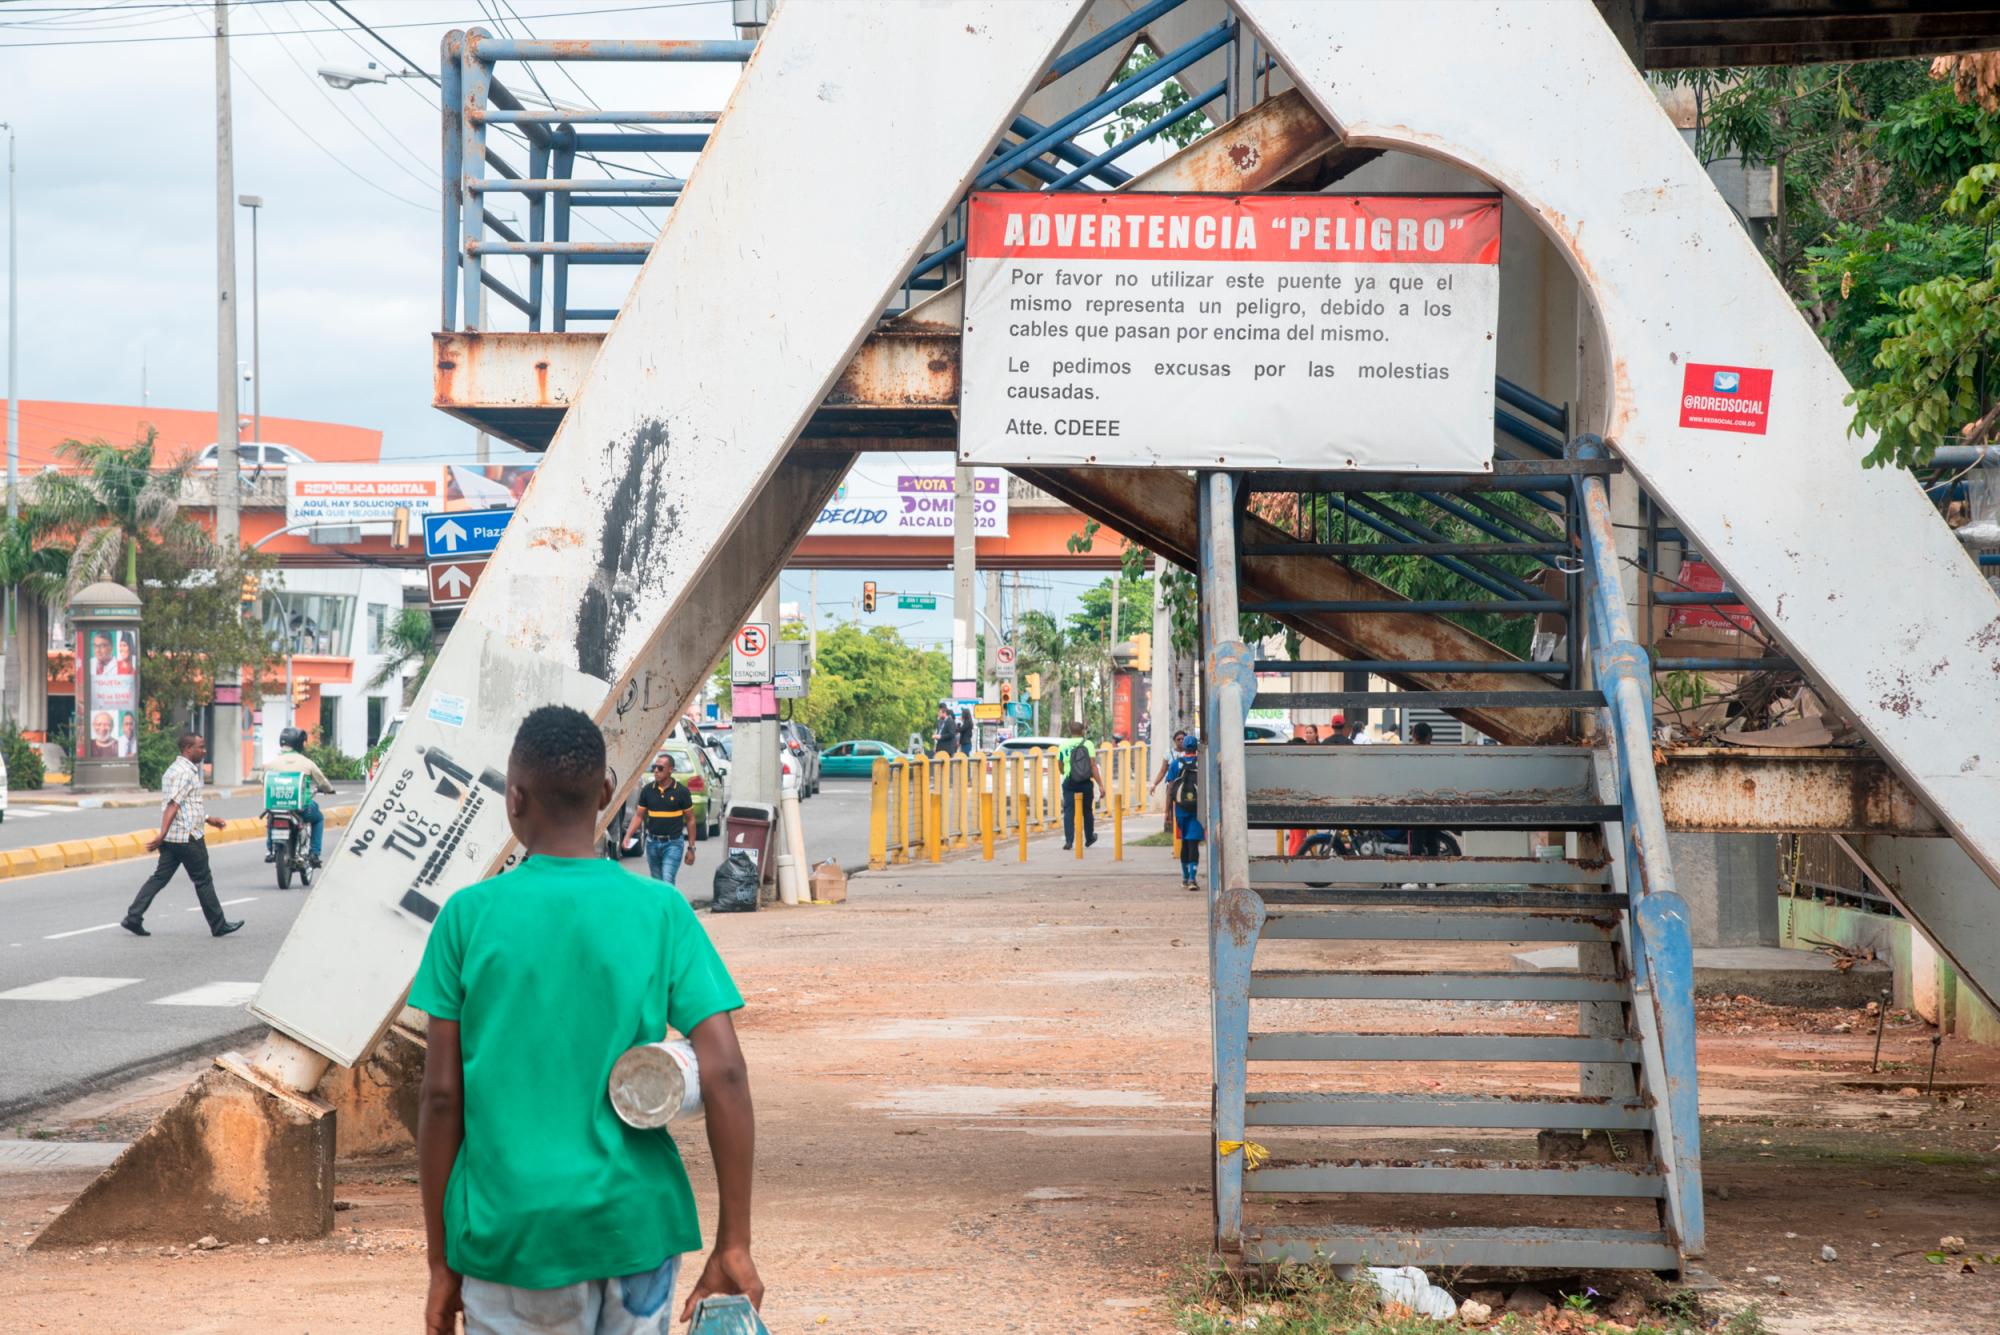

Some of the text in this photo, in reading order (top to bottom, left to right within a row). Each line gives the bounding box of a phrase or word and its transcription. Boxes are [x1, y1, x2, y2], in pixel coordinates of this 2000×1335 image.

[1003, 213, 1257, 250] ADVERTENCIA
[1011, 268, 1453, 294] Por favor no utilizar este puente ya que el
[1010, 294, 1452, 319] mismo representa un peligro, debido a los
[1009, 320, 1389, 344] cables que pasan por encima del mismo.
[1008, 356, 1449, 381] Le pedimos excusas por las molestias
[1007, 383, 1100, 400] causadas.
[1683, 394, 1764, 415] @RDREDSOCIAL
[1005, 418, 1120, 437] Atte. CDEEE
[304, 481, 428, 494] REPÚBLICA DIGITAL
[913, 479, 947, 491] VOTA
[331, 500, 350, 508] HAY
[353, 500, 413, 508] SOLUCIONES
[416, 500, 429, 508] EN
[900, 495, 996, 514] DOMIGO
[899, 516, 953, 528] ALCALD
[734, 670, 767, 678] ESTACIONE
[349, 768, 414, 857] No Botes
[381, 820, 427, 861] TU
